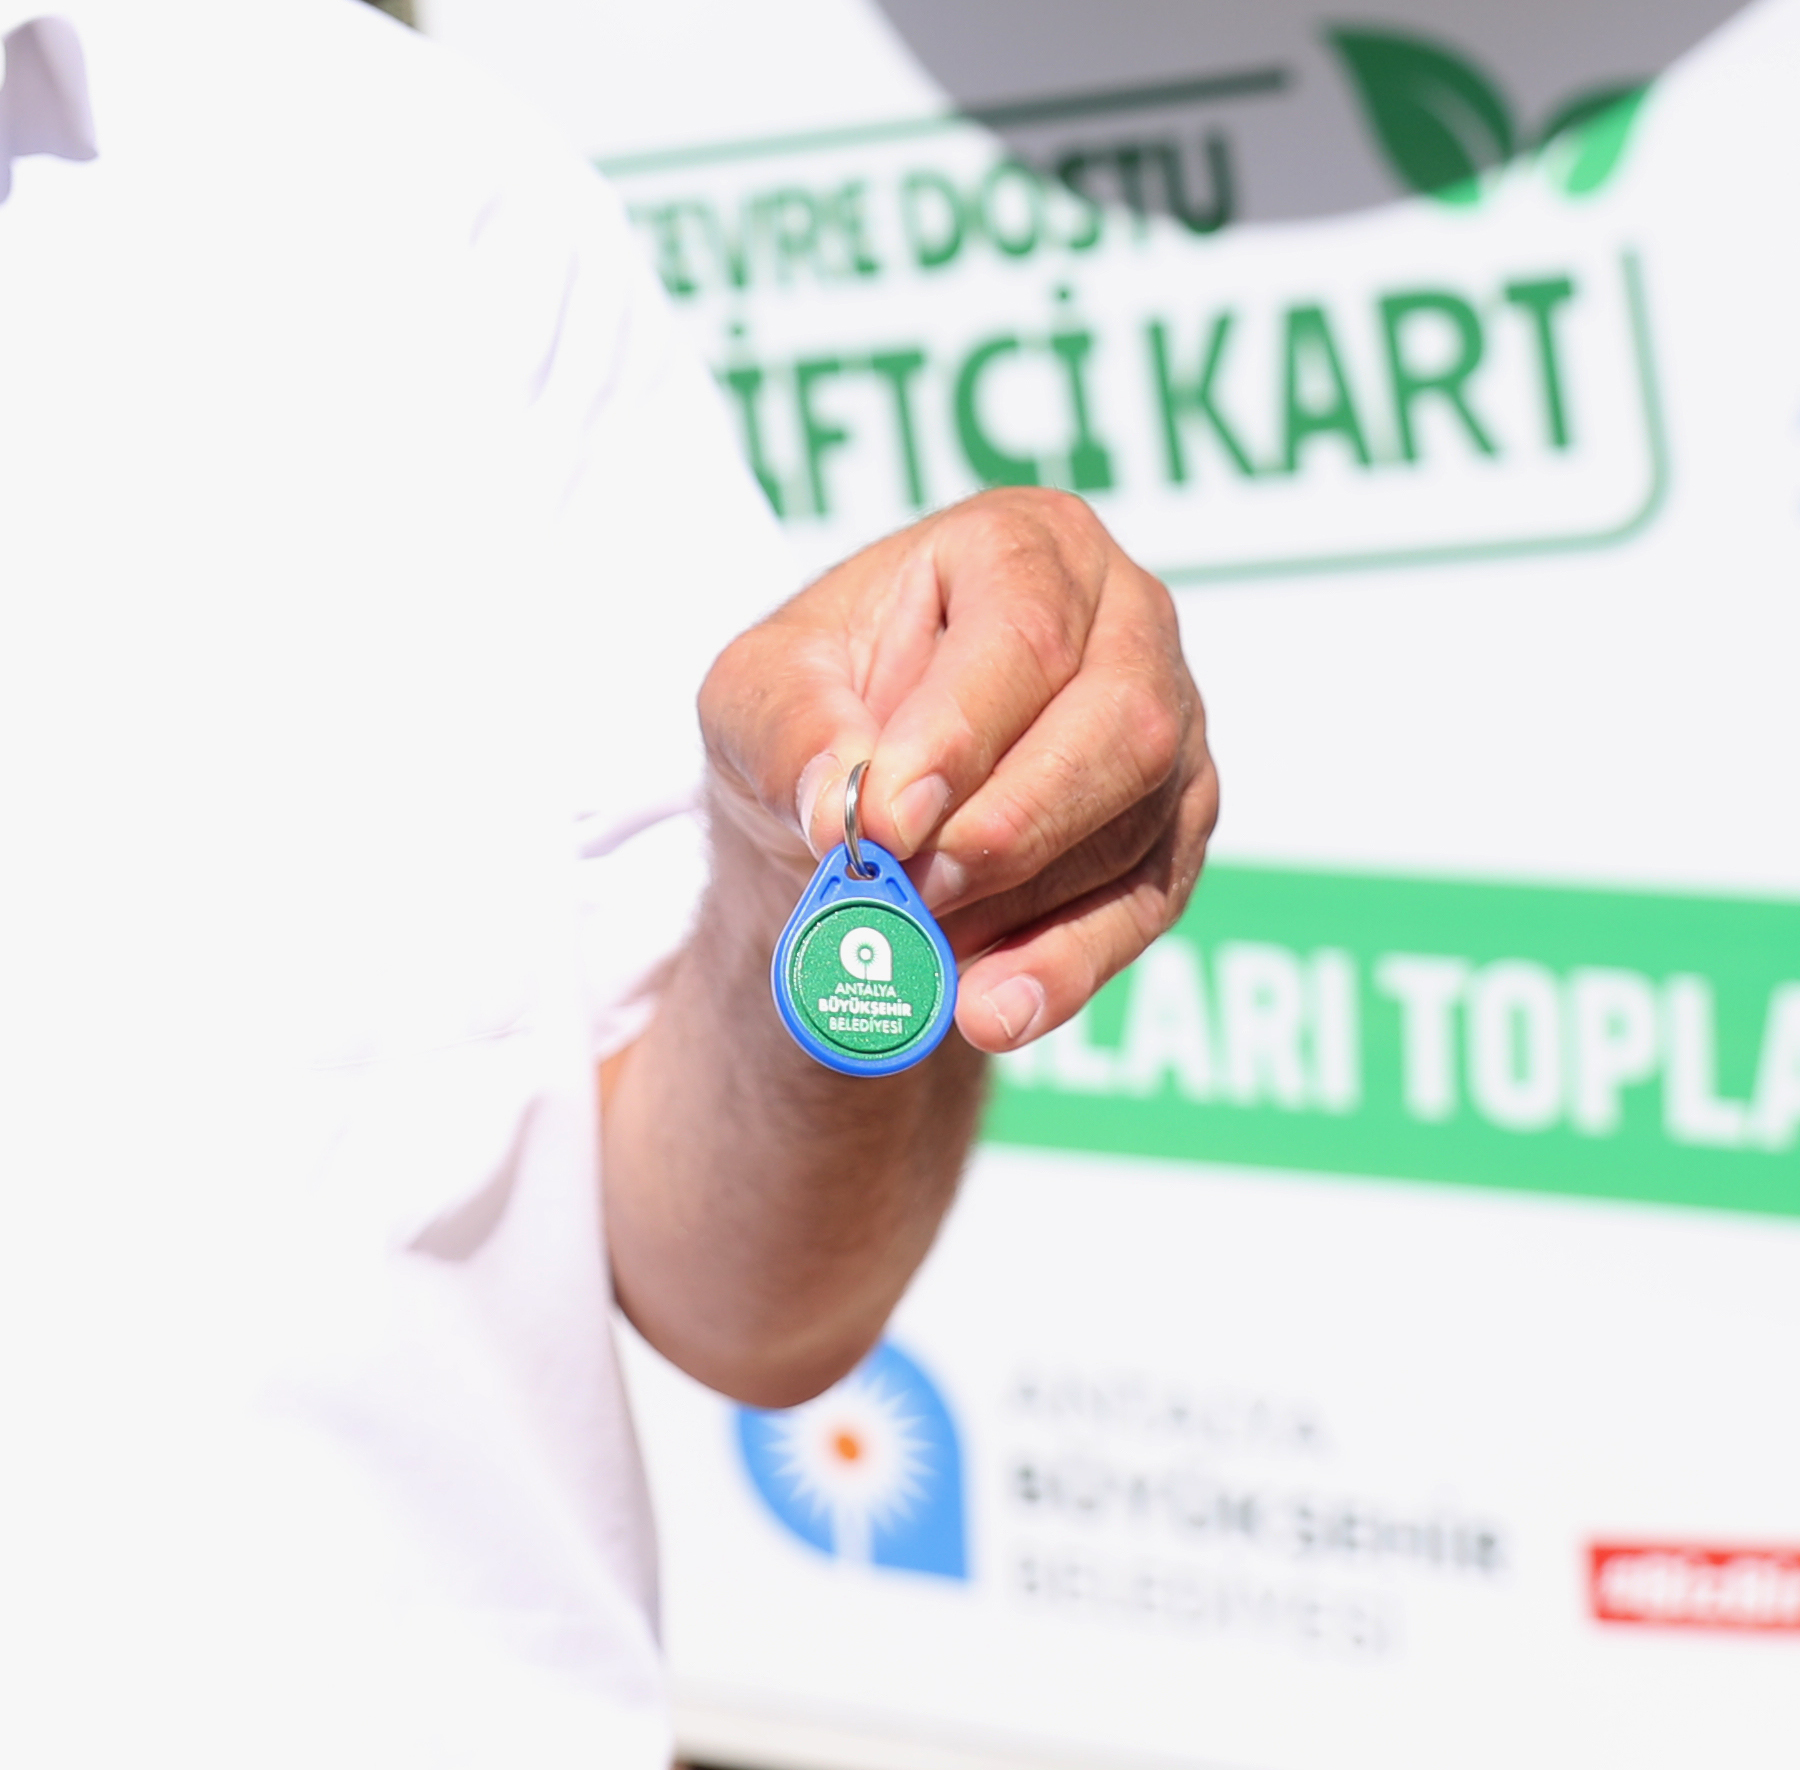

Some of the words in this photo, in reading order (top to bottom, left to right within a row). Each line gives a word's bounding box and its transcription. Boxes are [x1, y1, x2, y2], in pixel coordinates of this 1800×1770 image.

[624, 172, 886, 300] EVRE
[898, 122, 1242, 275] DOSTU
[706, 280, 1116, 522] İFTÇİ
[1144, 266, 1582, 496] KART
[818, 995, 913, 1017] BÜYÜKŞEHİR
[828, 1016, 904, 1035] BELEDİYESİ
[834, 982, 898, 998] ANTALYA
[1003, 934, 1362, 1116] LARI
